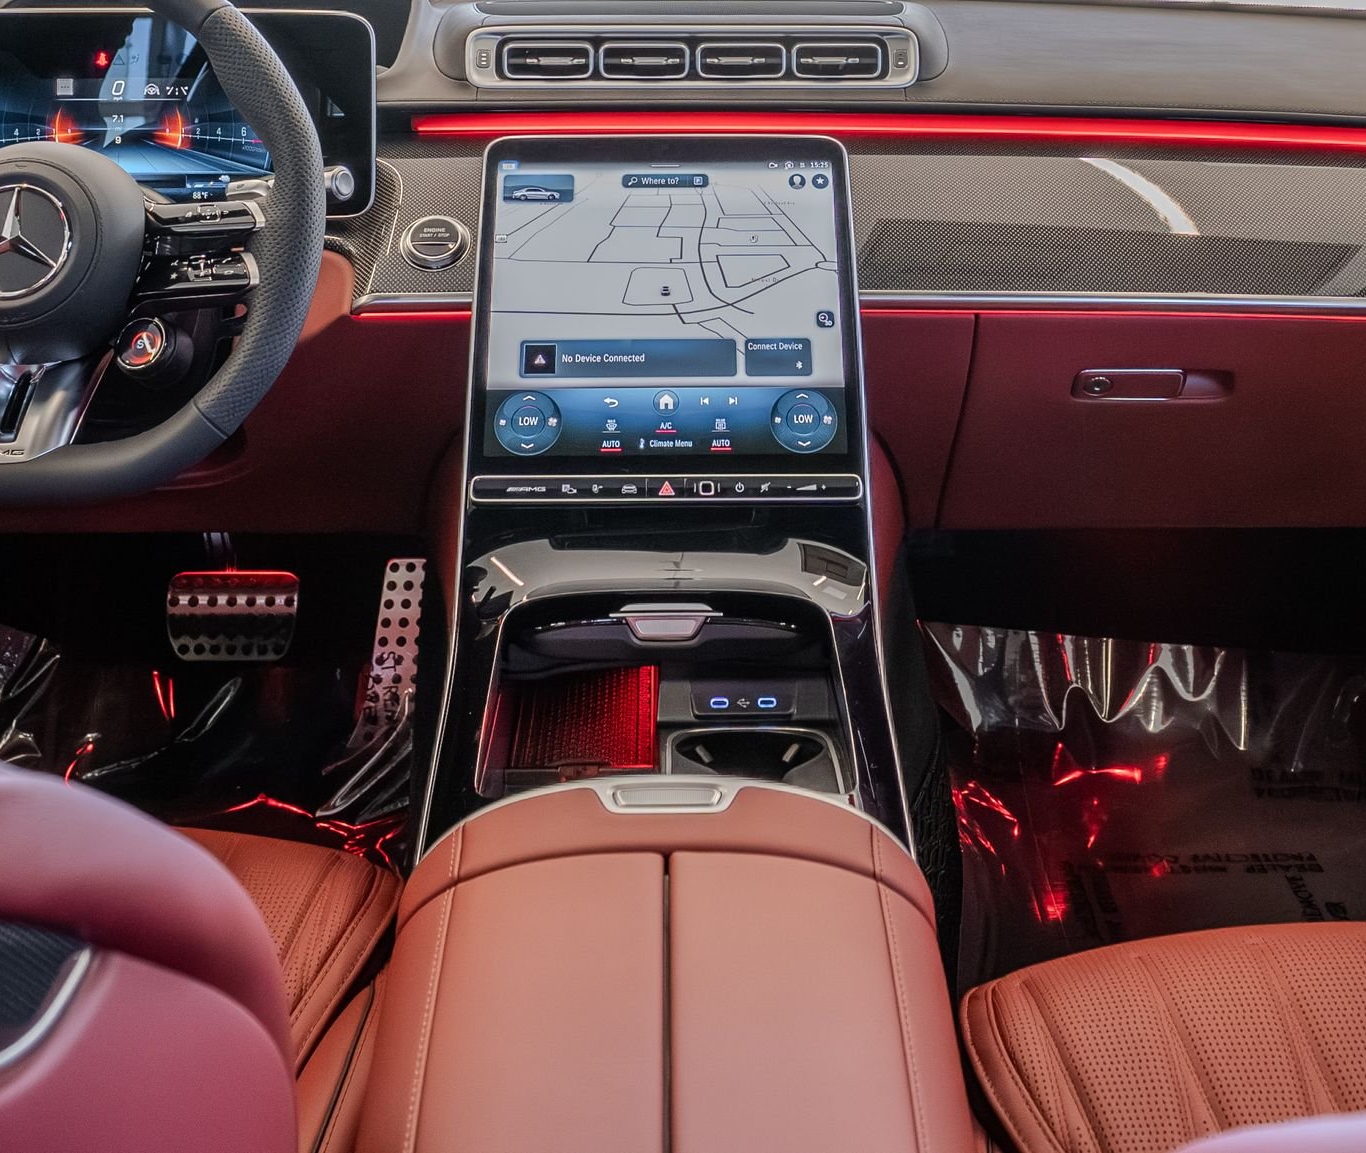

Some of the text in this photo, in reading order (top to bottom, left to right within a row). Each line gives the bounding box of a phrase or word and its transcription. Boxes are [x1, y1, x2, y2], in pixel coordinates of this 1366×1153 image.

[112, 80, 125, 96] 0
[112, 114, 124, 122] 7.1
[14, 128, 20, 136] 4
[241, 126, 247, 136] 6
[115, 136, 122, 144] 9
[641, 176, 679, 185] Where to?
[748, 342, 803, 350] Connect Device
[562, 353, 645, 362] No Device Connected
[518, 416, 538, 427] LOW
[793, 414, 814, 424] LOW
[660, 422, 672, 430] A/C
[650, 440, 693, 448] Climate Menu
